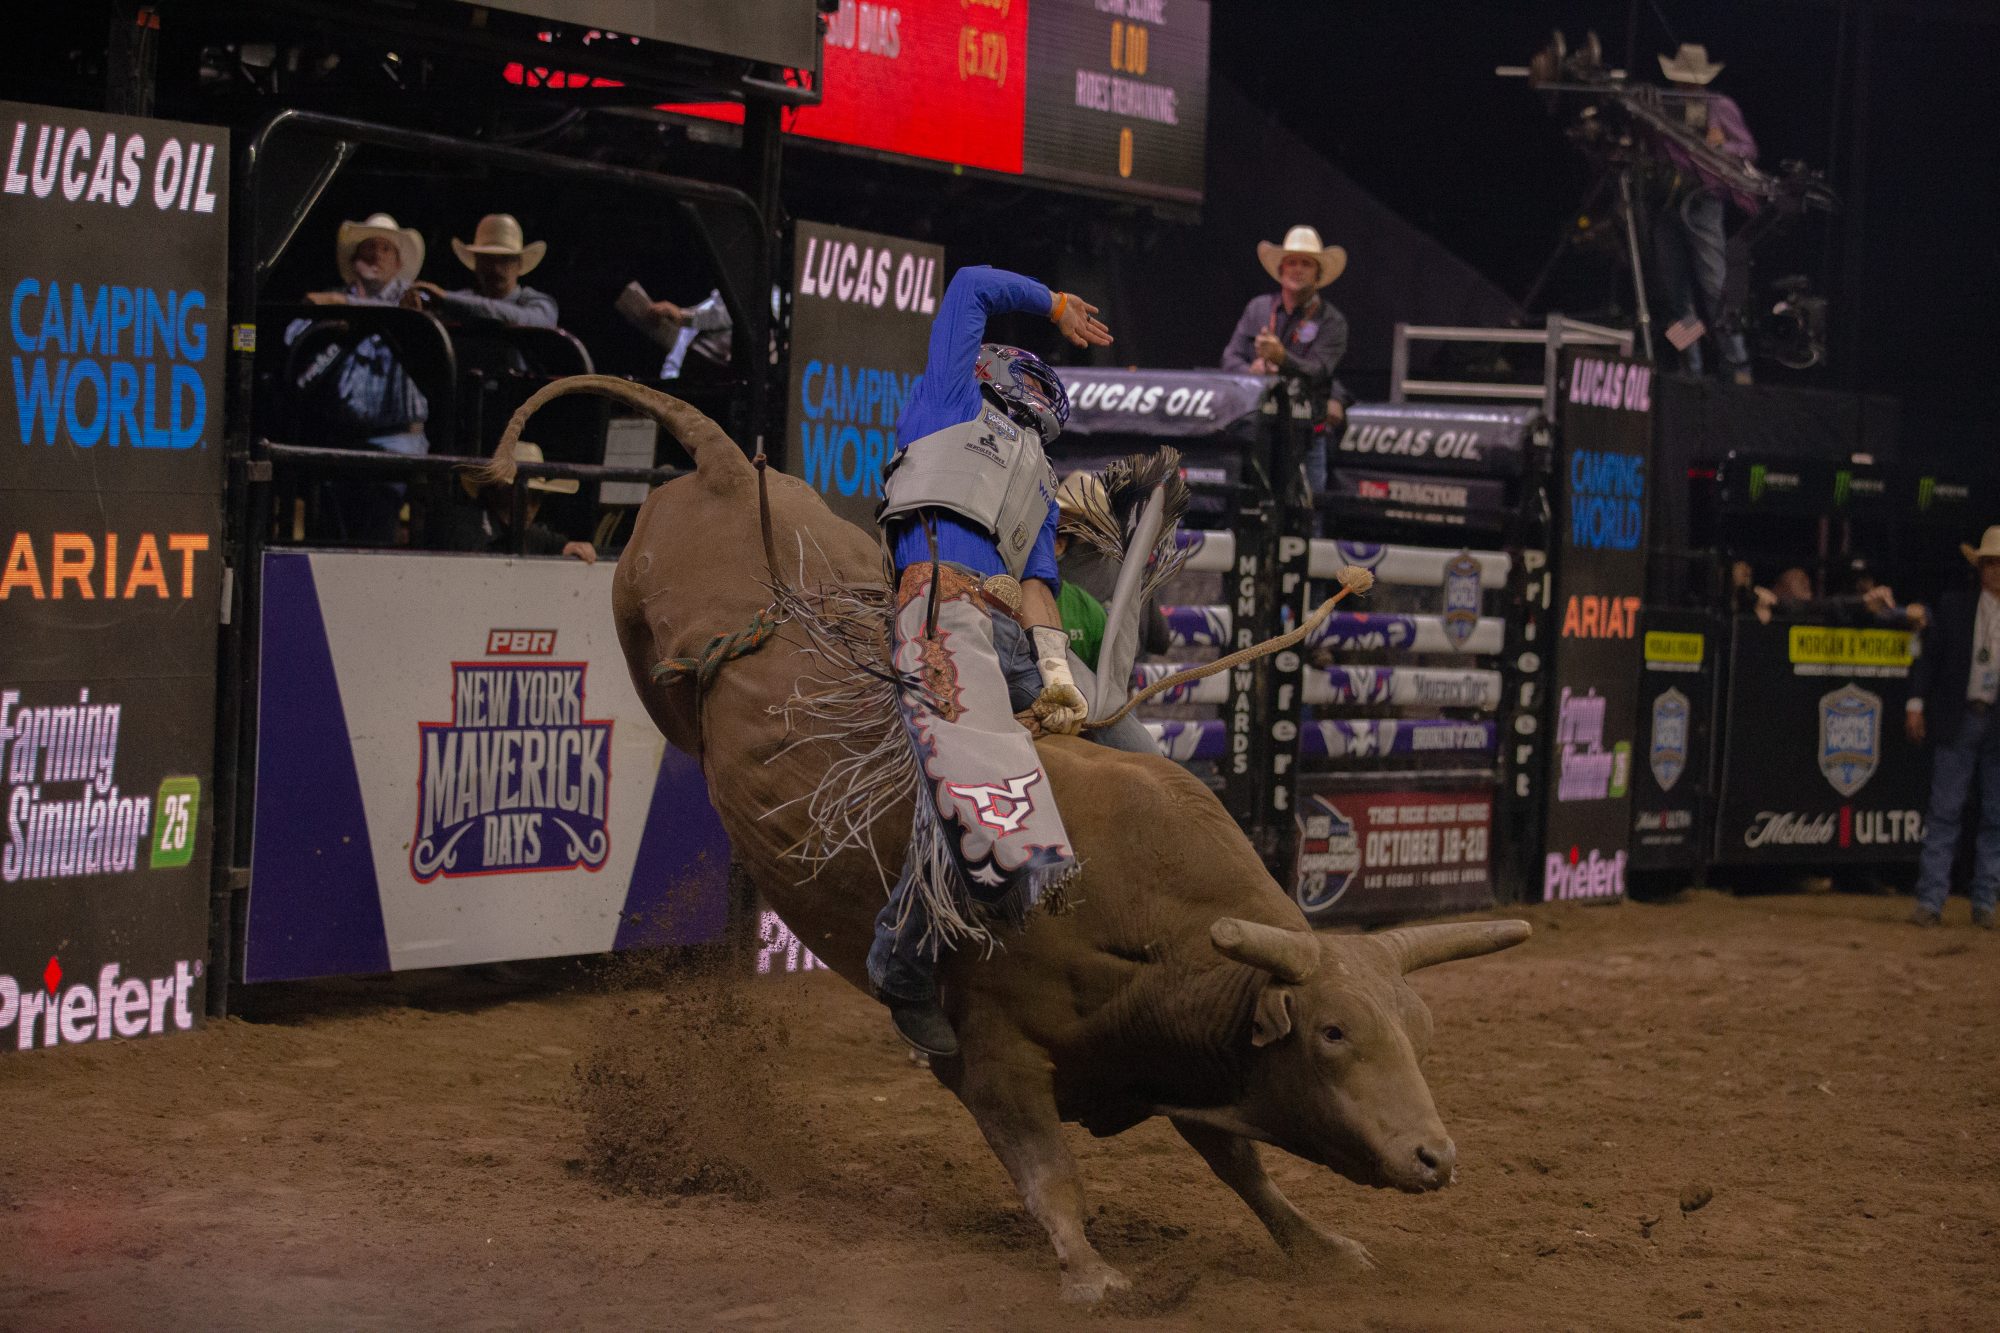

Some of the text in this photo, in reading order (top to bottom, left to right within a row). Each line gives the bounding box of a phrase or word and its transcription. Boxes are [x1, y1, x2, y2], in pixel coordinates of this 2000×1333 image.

[4, 121, 216, 213] LUCAS OIL
[800, 237, 935, 315] LUCAS OIL
[10, 277, 207, 362] CAMPING
[11, 355, 206, 449] WORLD
[802, 358, 924, 427] CAMPIN
[1066, 381, 1216, 418] LUCAS OIL
[1569, 356, 1650, 412] LUCAS OIL
[801, 421, 896, 498] WOR
[1340, 423, 1480, 460] LUCAS OIL
[1570, 449, 1645, 497] CAMPING
[1571, 495, 1642, 550] WORLD
[0, 532, 209, 600] ARIAT
[489, 632, 554, 652] PBR
[1562, 595, 1641, 638] ARIAT
[456, 670, 582, 728] NEW YORK
[1233, 628, 1253, 774] RWARDS
[0, 688, 121, 793] Farming
[422, 728, 606, 839] MAVERICK
[4, 784, 150, 881] Simulator
[160, 794, 190, 851] 25
[482, 812, 542, 867] DAYS
[1365, 829, 1440, 868] OCTOBER
[1855, 810, 1928, 844] ULTR
[1543, 850, 1628, 902] Priefert
